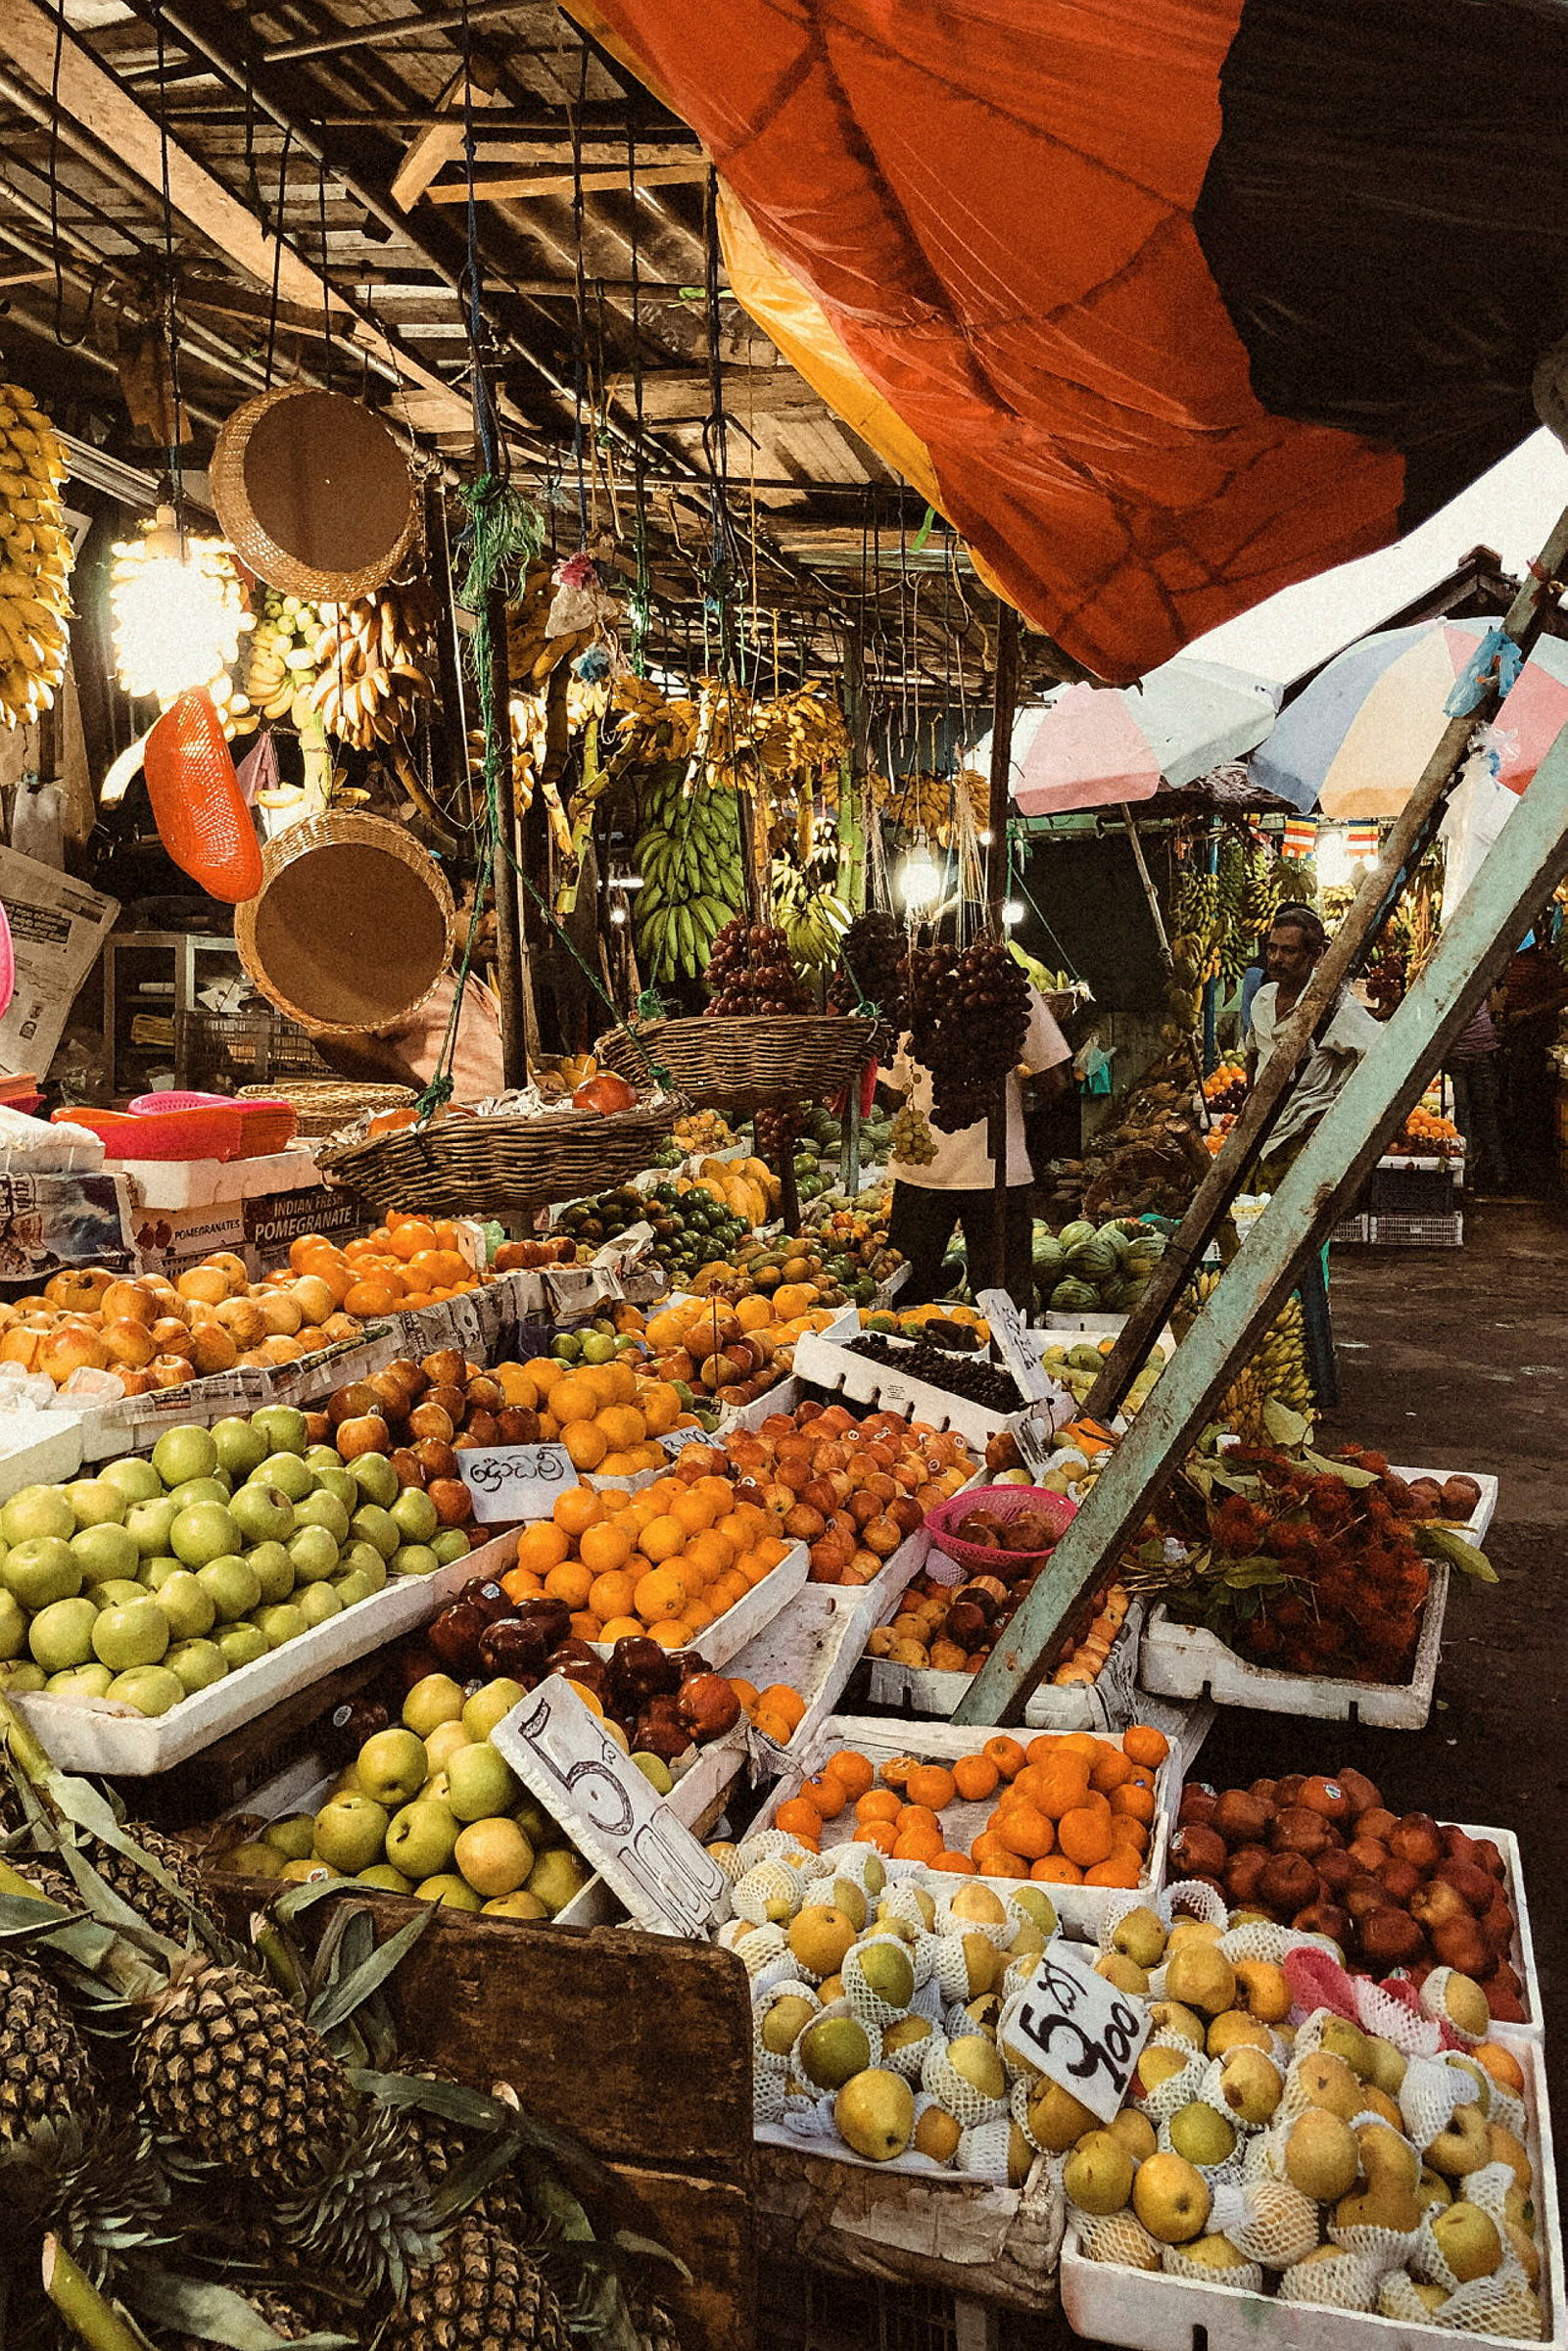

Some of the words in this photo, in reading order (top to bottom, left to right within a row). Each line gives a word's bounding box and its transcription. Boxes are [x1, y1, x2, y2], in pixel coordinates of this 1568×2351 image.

[274, 1199, 313, 1218] INDIAN
[315, 1193, 345, 1210] FRESH
[174, 1220, 240, 1241] POMEGRANATES
[255, 1206, 353, 1242] POMEGRANATE
